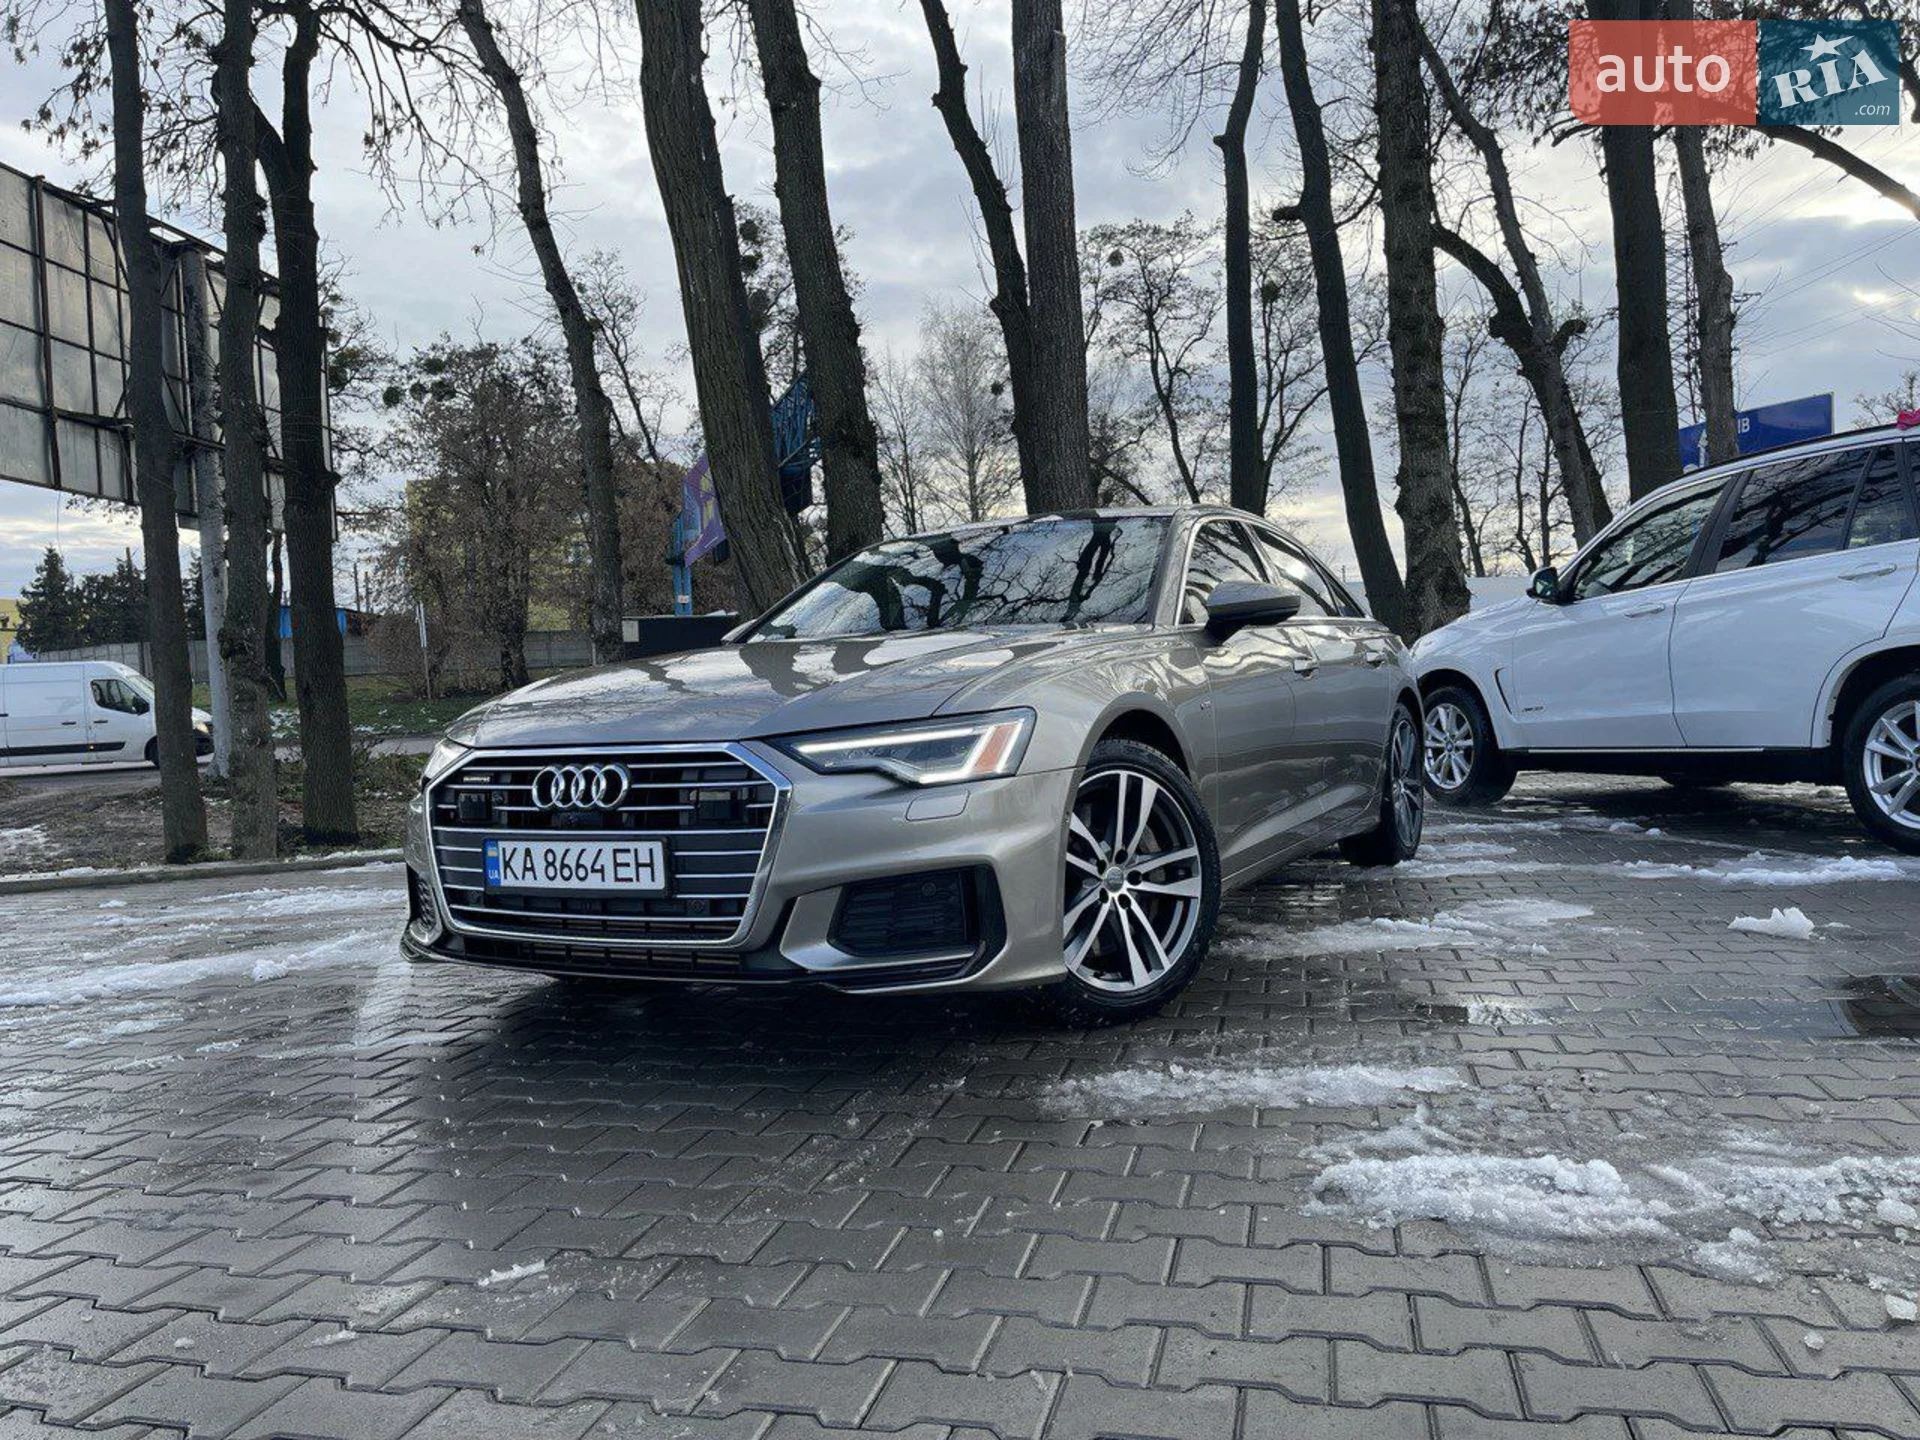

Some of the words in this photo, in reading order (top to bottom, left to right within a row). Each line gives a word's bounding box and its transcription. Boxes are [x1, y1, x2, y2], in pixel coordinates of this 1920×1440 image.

[488, 869, 500, 880] UA
[502, 847, 537, 880] KA
[544, 848, 606, 882] 8664
[612, 848, 656, 883] EH
